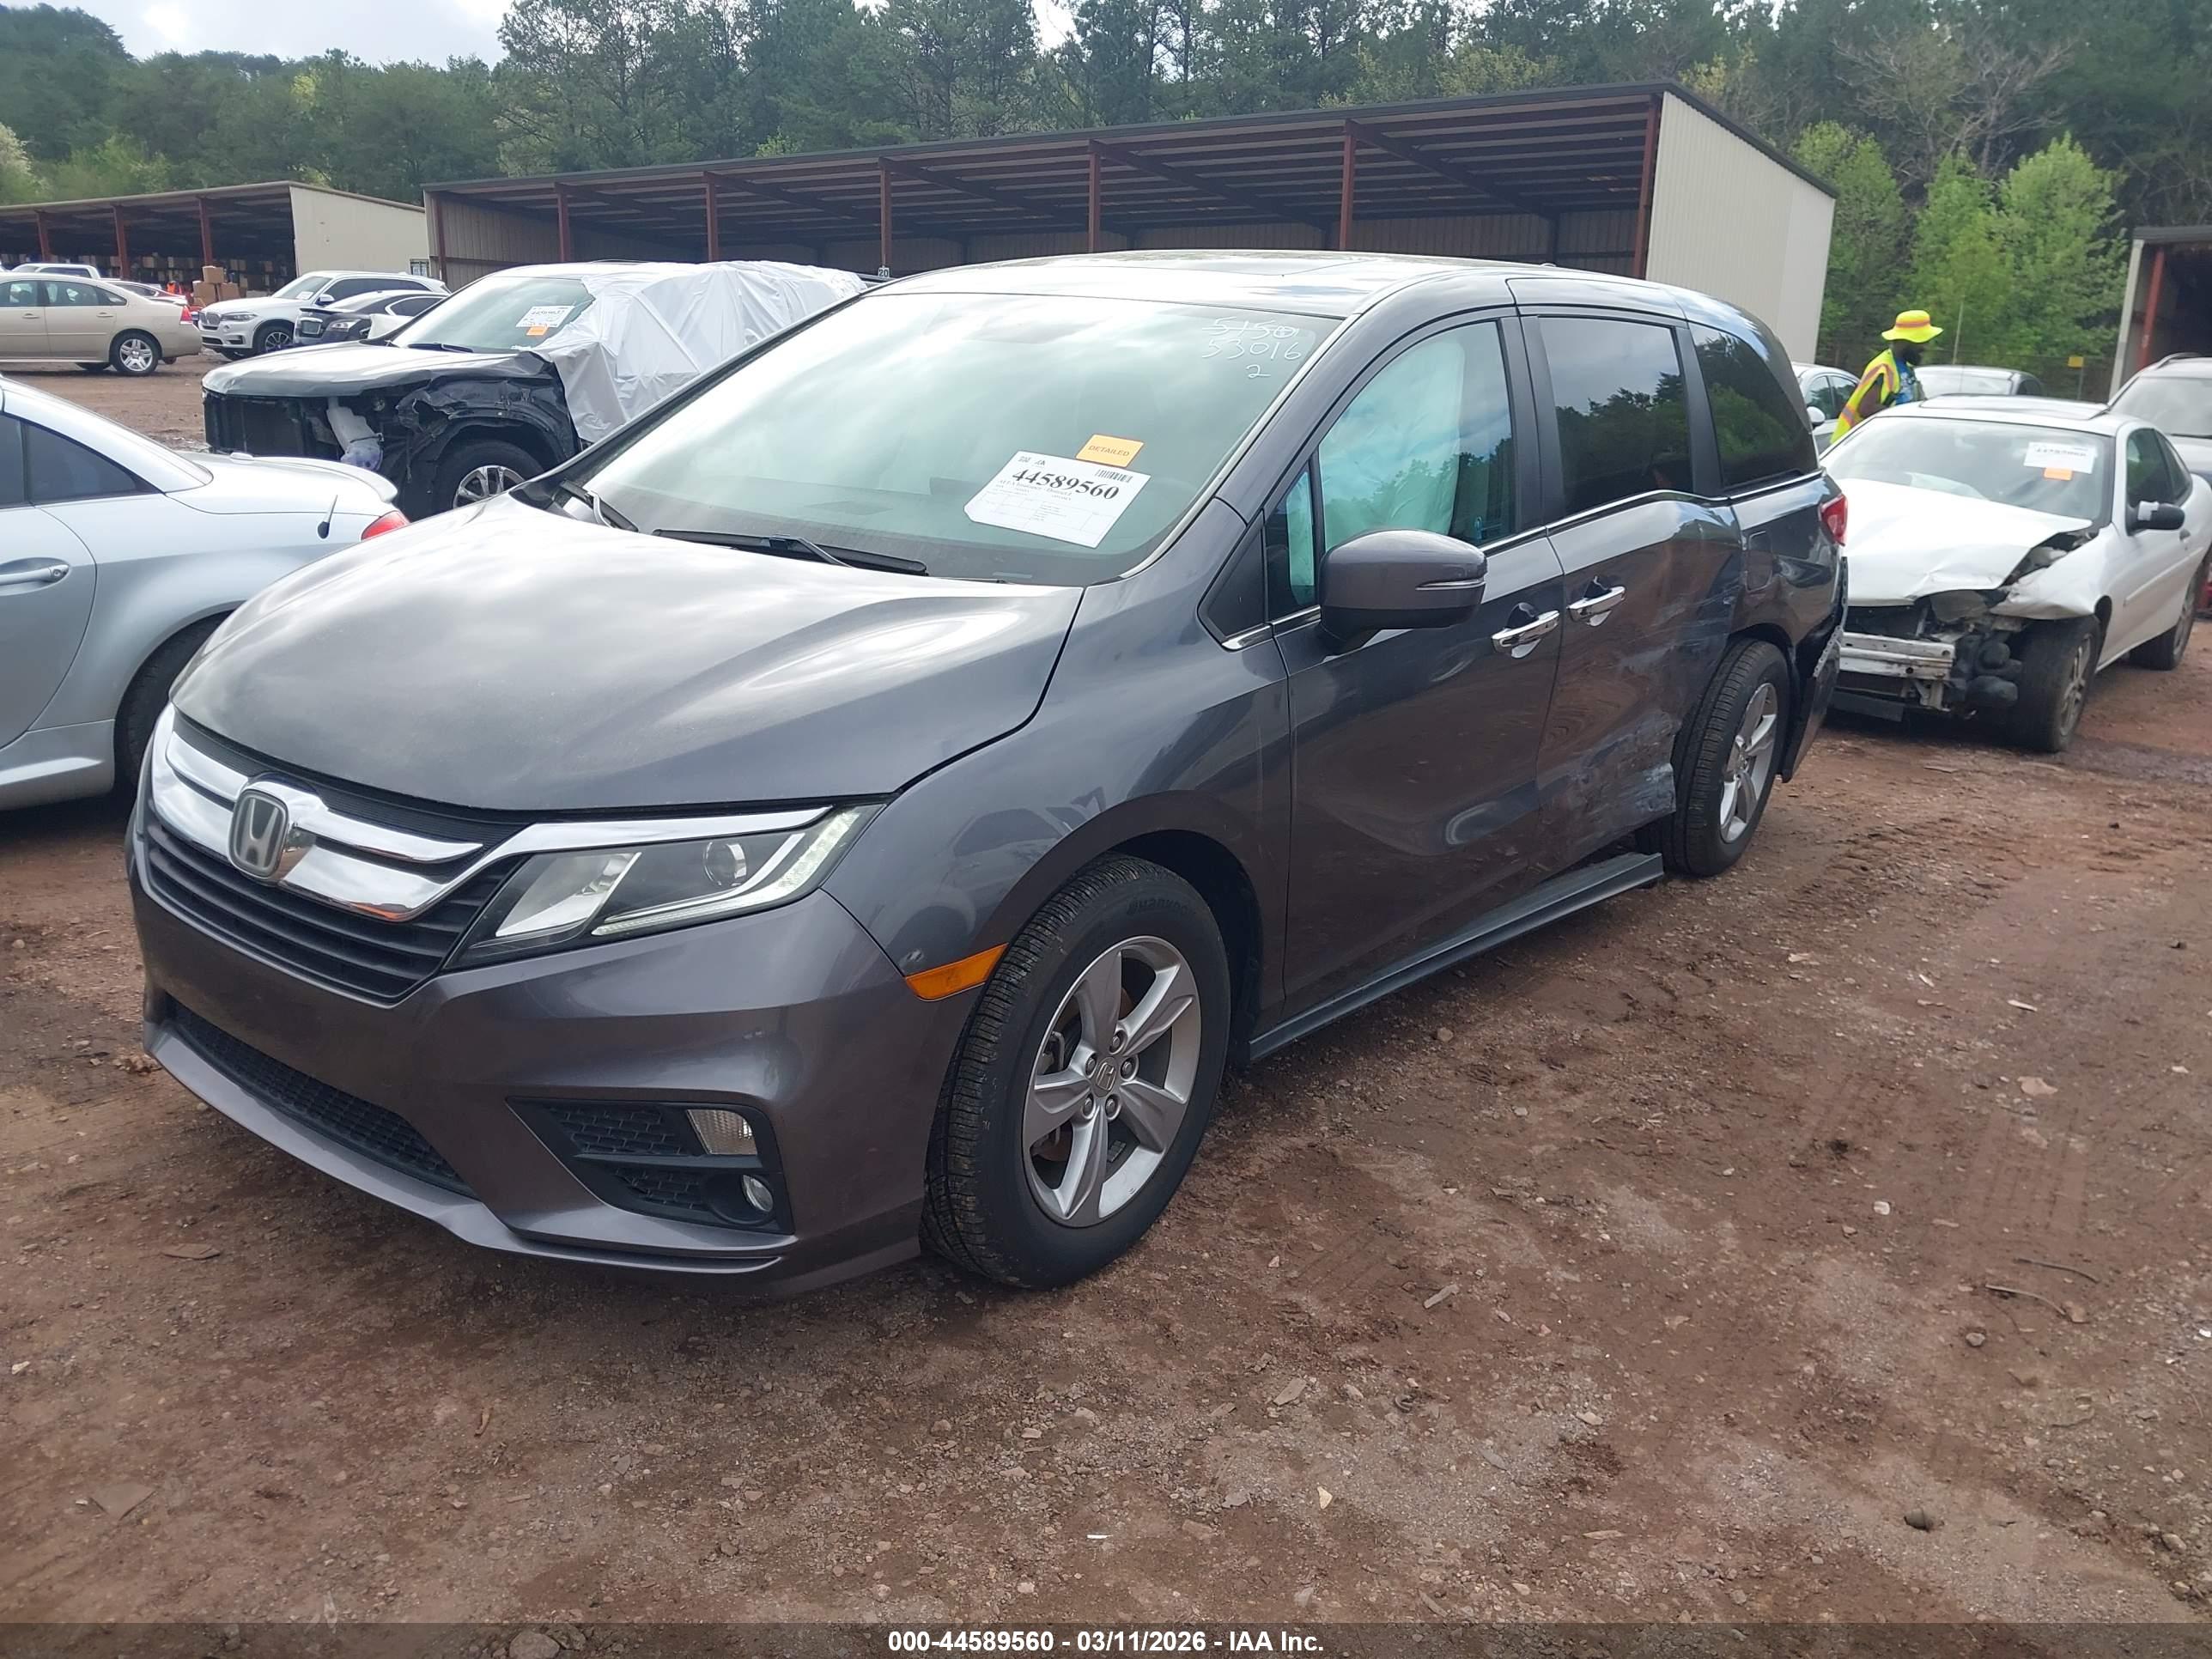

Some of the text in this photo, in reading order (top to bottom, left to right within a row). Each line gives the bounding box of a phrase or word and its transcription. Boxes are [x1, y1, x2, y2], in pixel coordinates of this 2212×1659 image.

[1202, 338, 1302, 361] 53016
[1245, 364, 1271, 379] 2
[1087, 444, 1130, 458] DETAILED
[1012, 468, 1121, 501] 44589560
